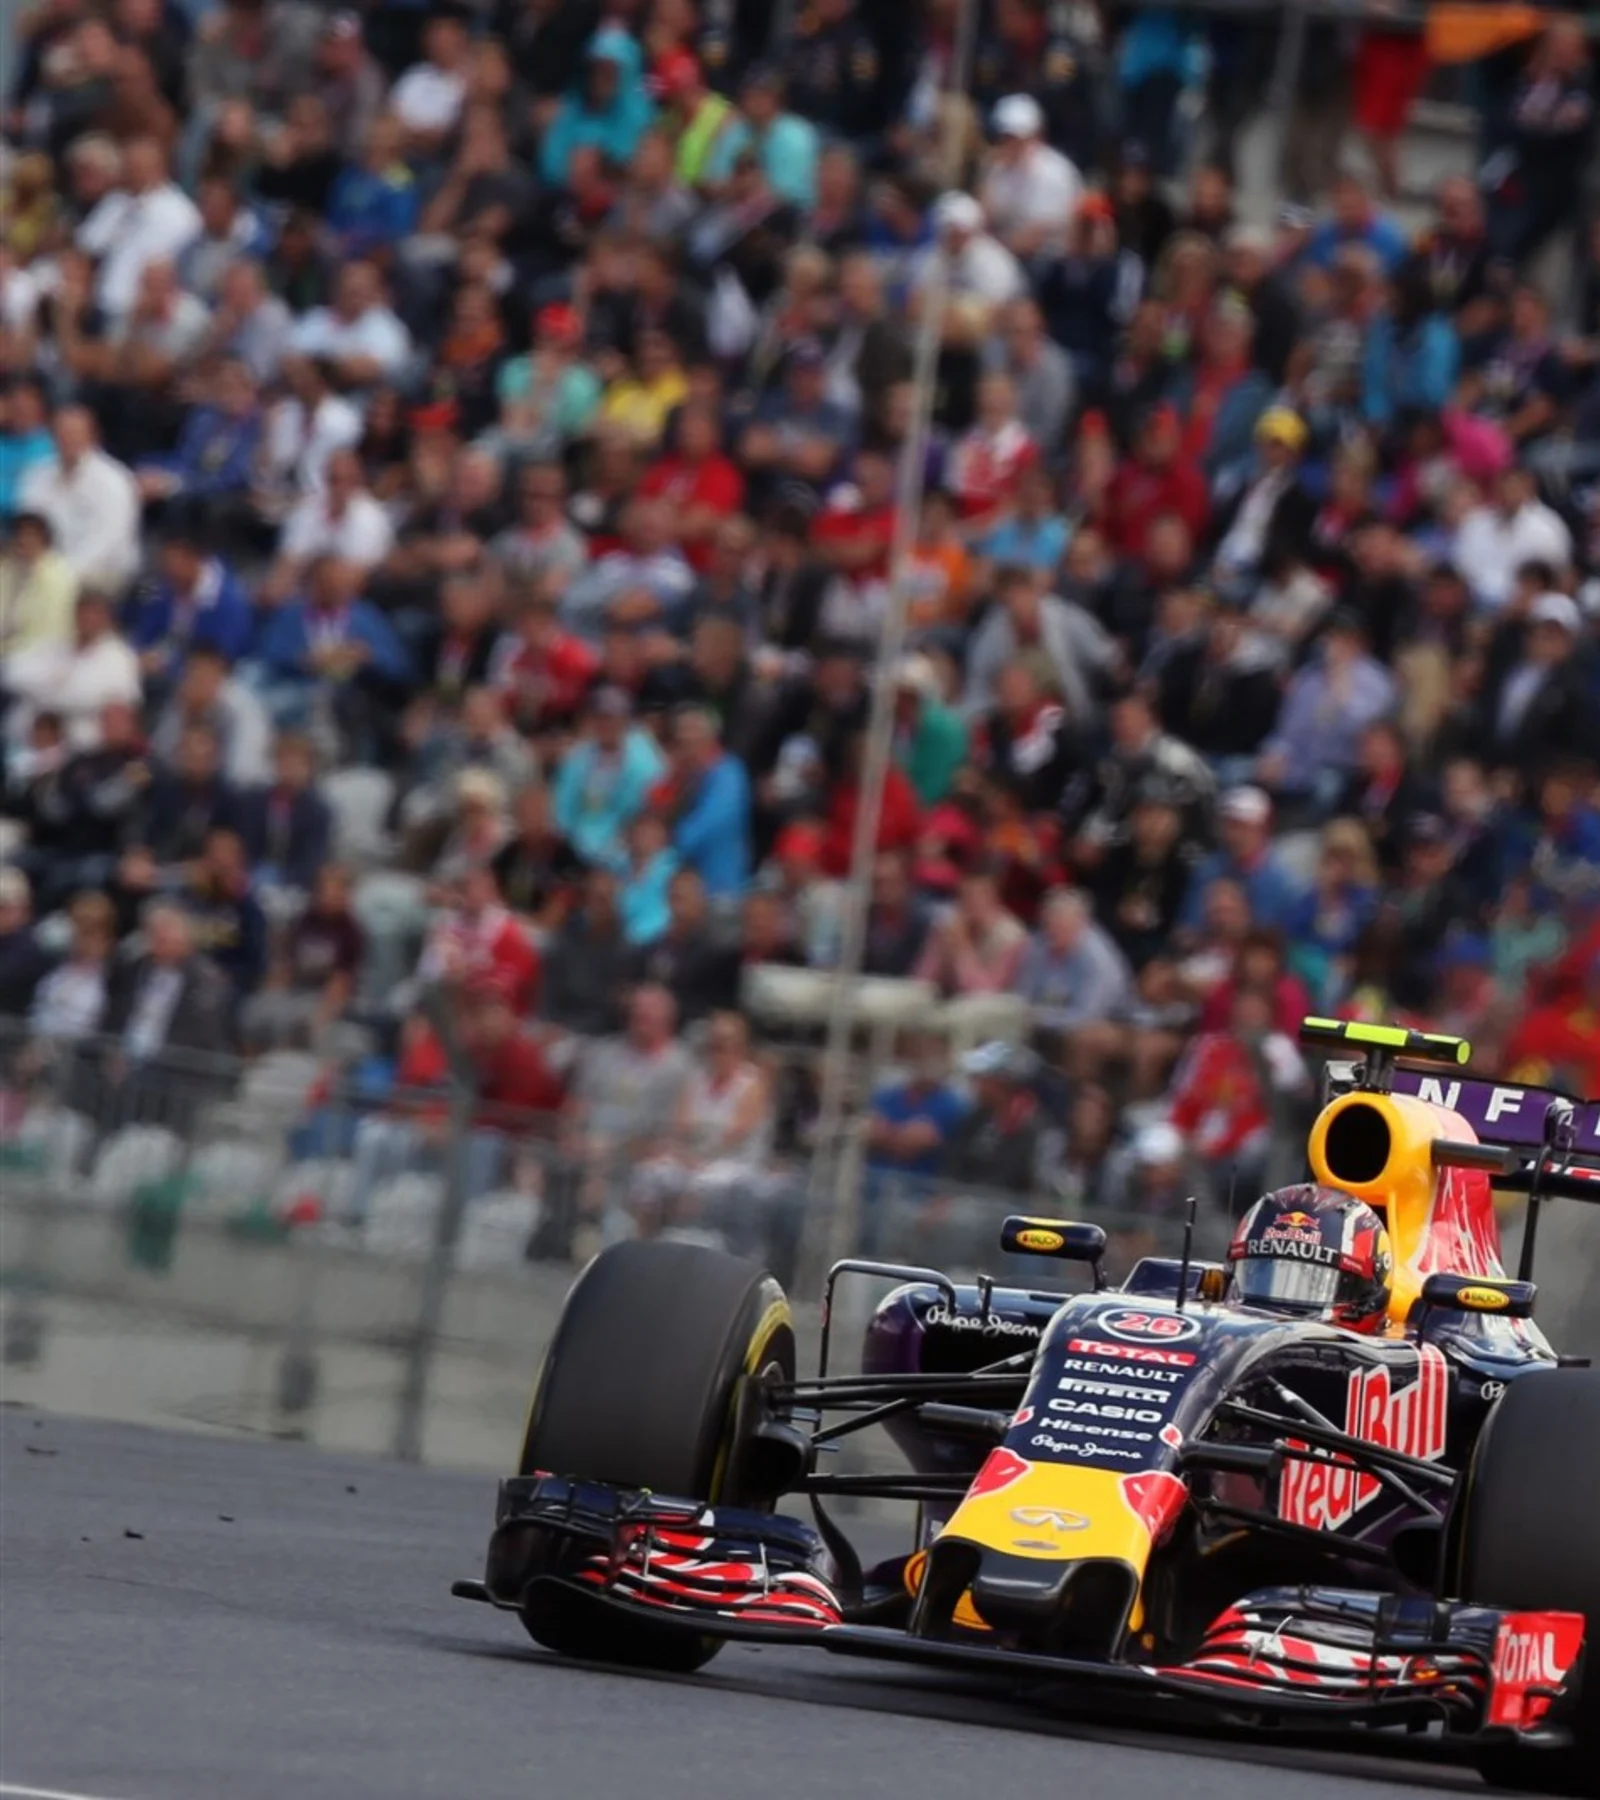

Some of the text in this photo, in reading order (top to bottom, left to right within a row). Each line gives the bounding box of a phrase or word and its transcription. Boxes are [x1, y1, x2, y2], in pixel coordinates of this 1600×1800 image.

[1247, 1238, 1339, 1264] RENAULT
[1113, 1313, 1186, 1337] 26
[1077, 1340, 1191, 1366] TOTAL
[1063, 1358, 1184, 1384] RENAULT
[1056, 1376, 1172, 1404] PIRELLI
[1047, 1398, 1163, 1424] CASIO
[1038, 1417, 1154, 1442] Hisense
[1494, 1622, 1568, 1683] TOTAL
